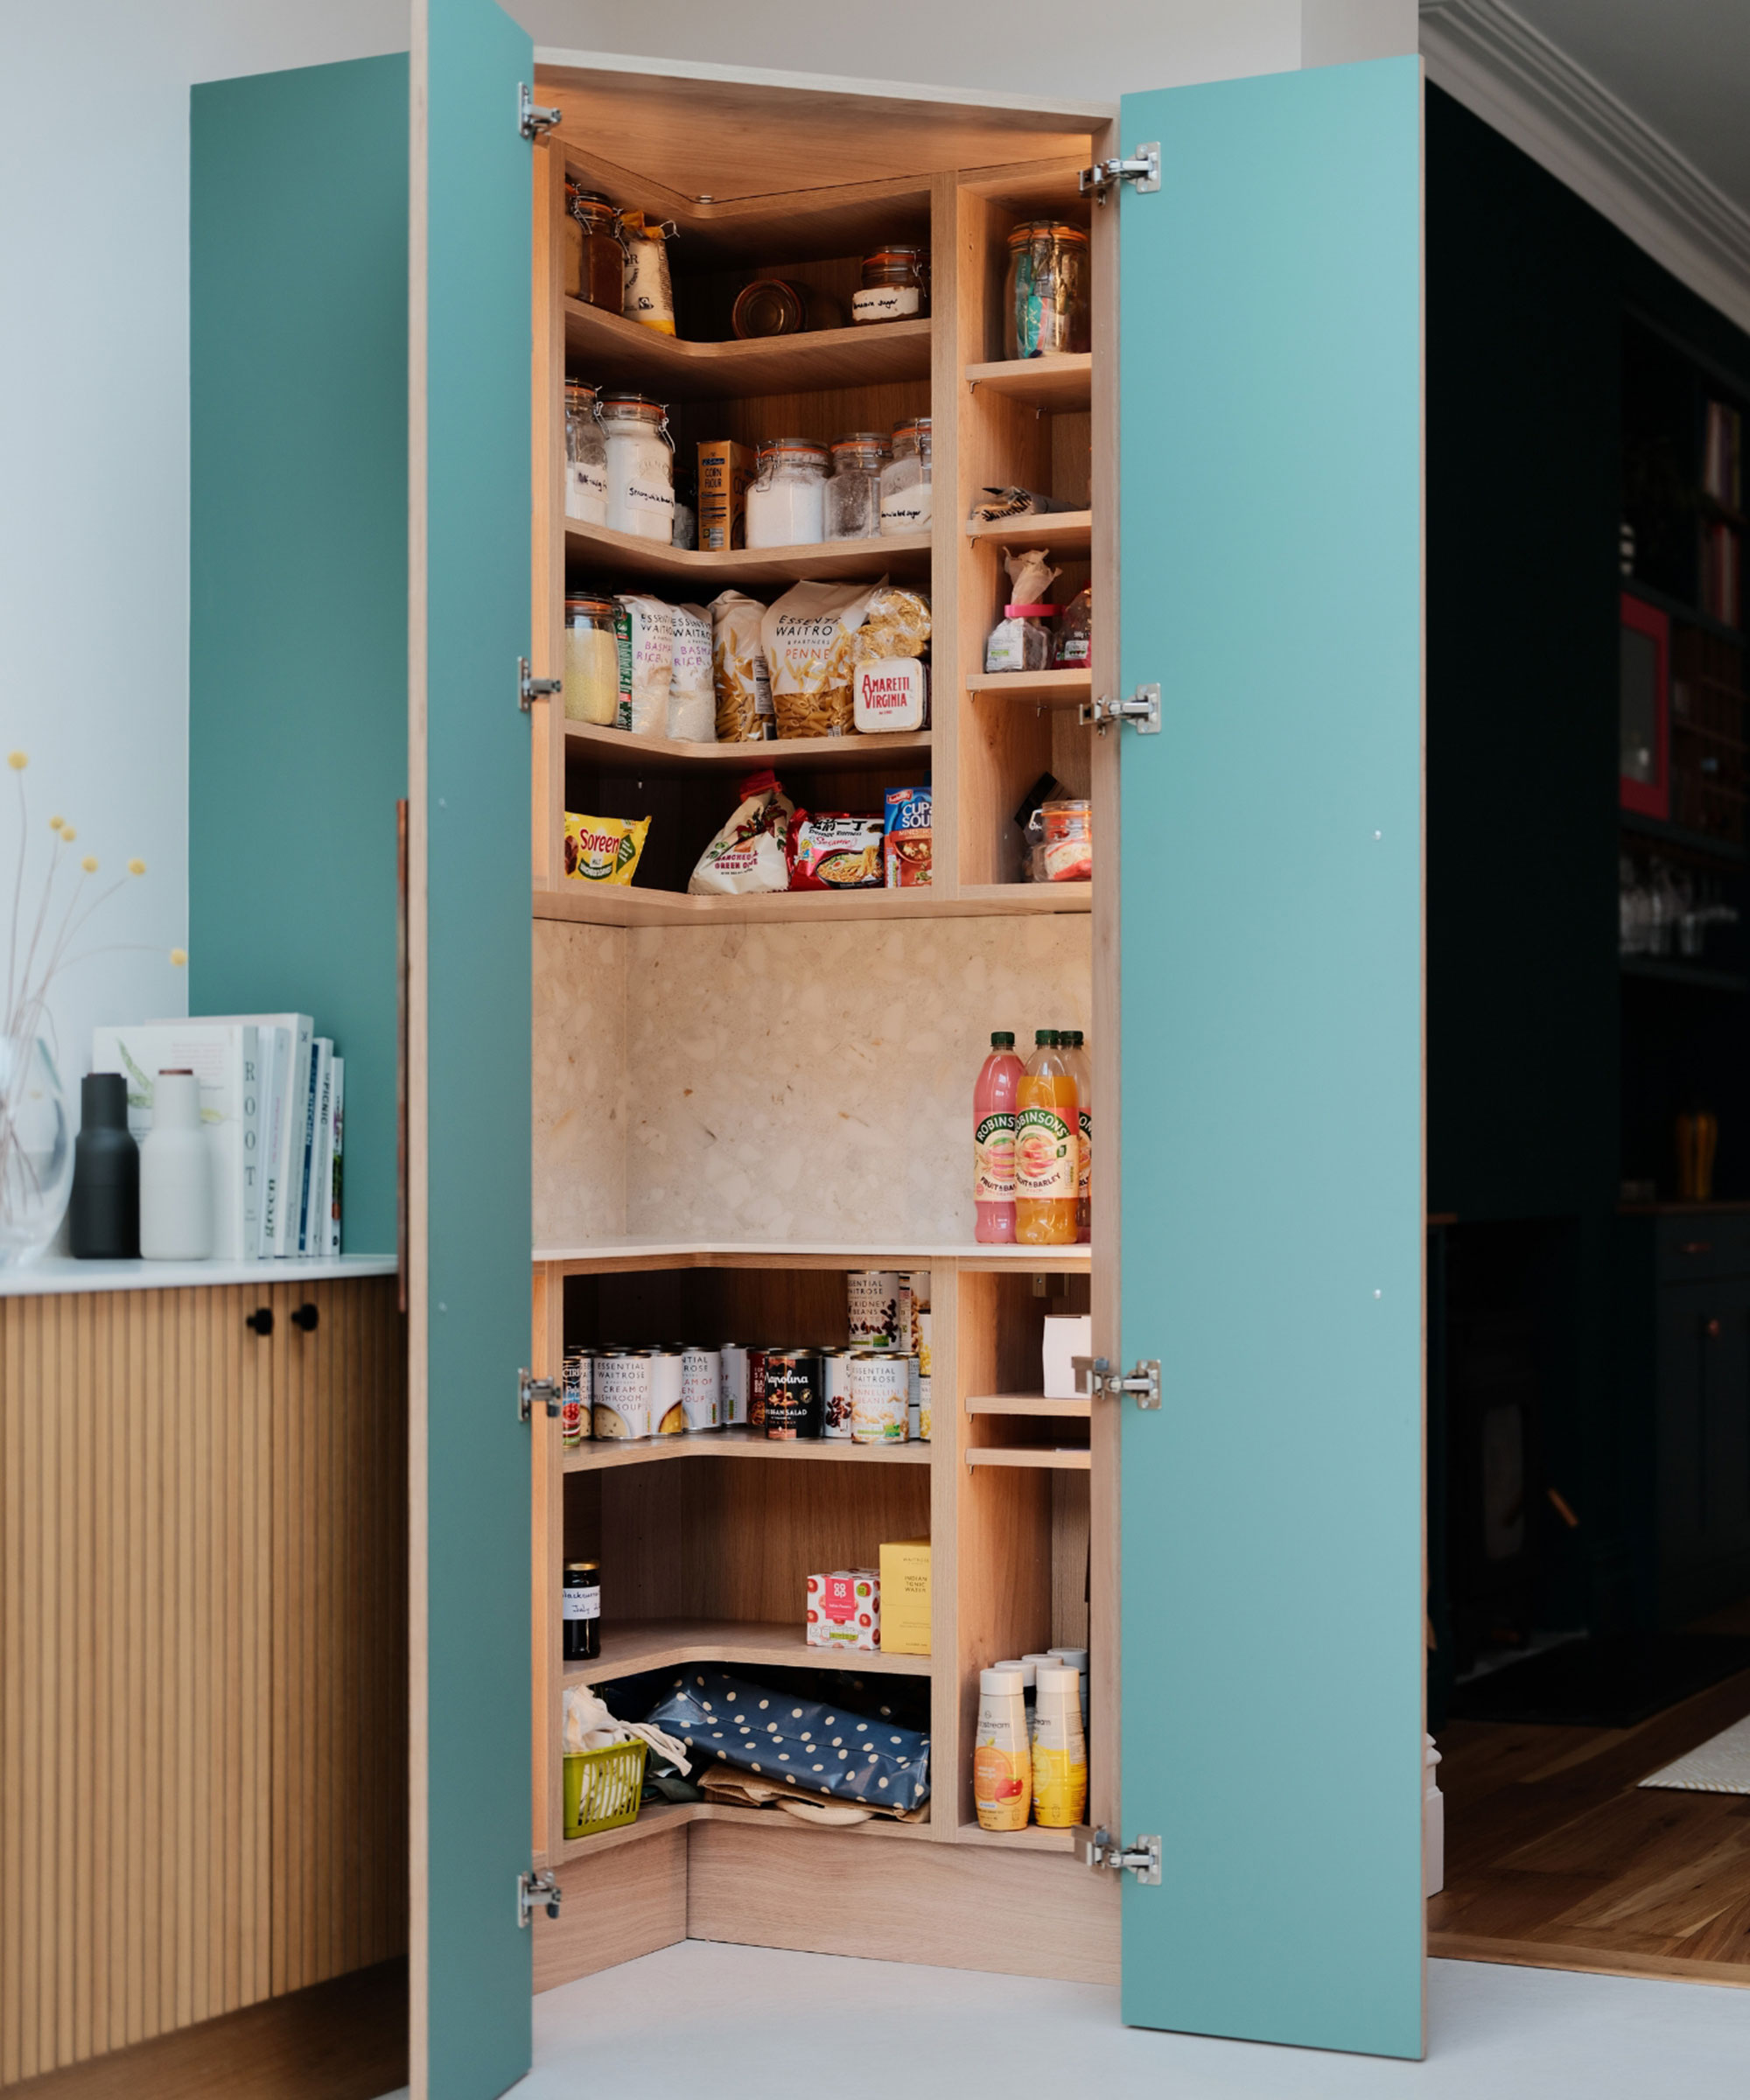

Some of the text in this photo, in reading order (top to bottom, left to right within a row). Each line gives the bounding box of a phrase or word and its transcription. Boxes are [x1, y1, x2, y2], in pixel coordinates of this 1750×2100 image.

[704, 467, 722, 478] CORN
[780, 615, 842, 626] ESSENTI
[673, 629, 710, 640] WAITRO
[777, 626, 833, 636] WAITRO
[636, 651, 661, 662] RICE
[786, 648, 830, 660] PENNE
[674, 656, 702, 666] RICE
[862, 675, 910, 693] AMARETTI
[864, 690, 907, 709] VIRGINIA
[902, 802, 928, 816] CUP
[902, 815, 932, 828] SOU
[579, 828, 620, 854] Soreen
[320, 1082, 330, 1125] PICNIC
[976, 1115, 1015, 1141] ROBINS
[980, 1176, 998, 1191] FRUIT
[1033, 1172, 1060, 1188] BARLEY
[598, 1371, 645, 1380] WAITROSE
